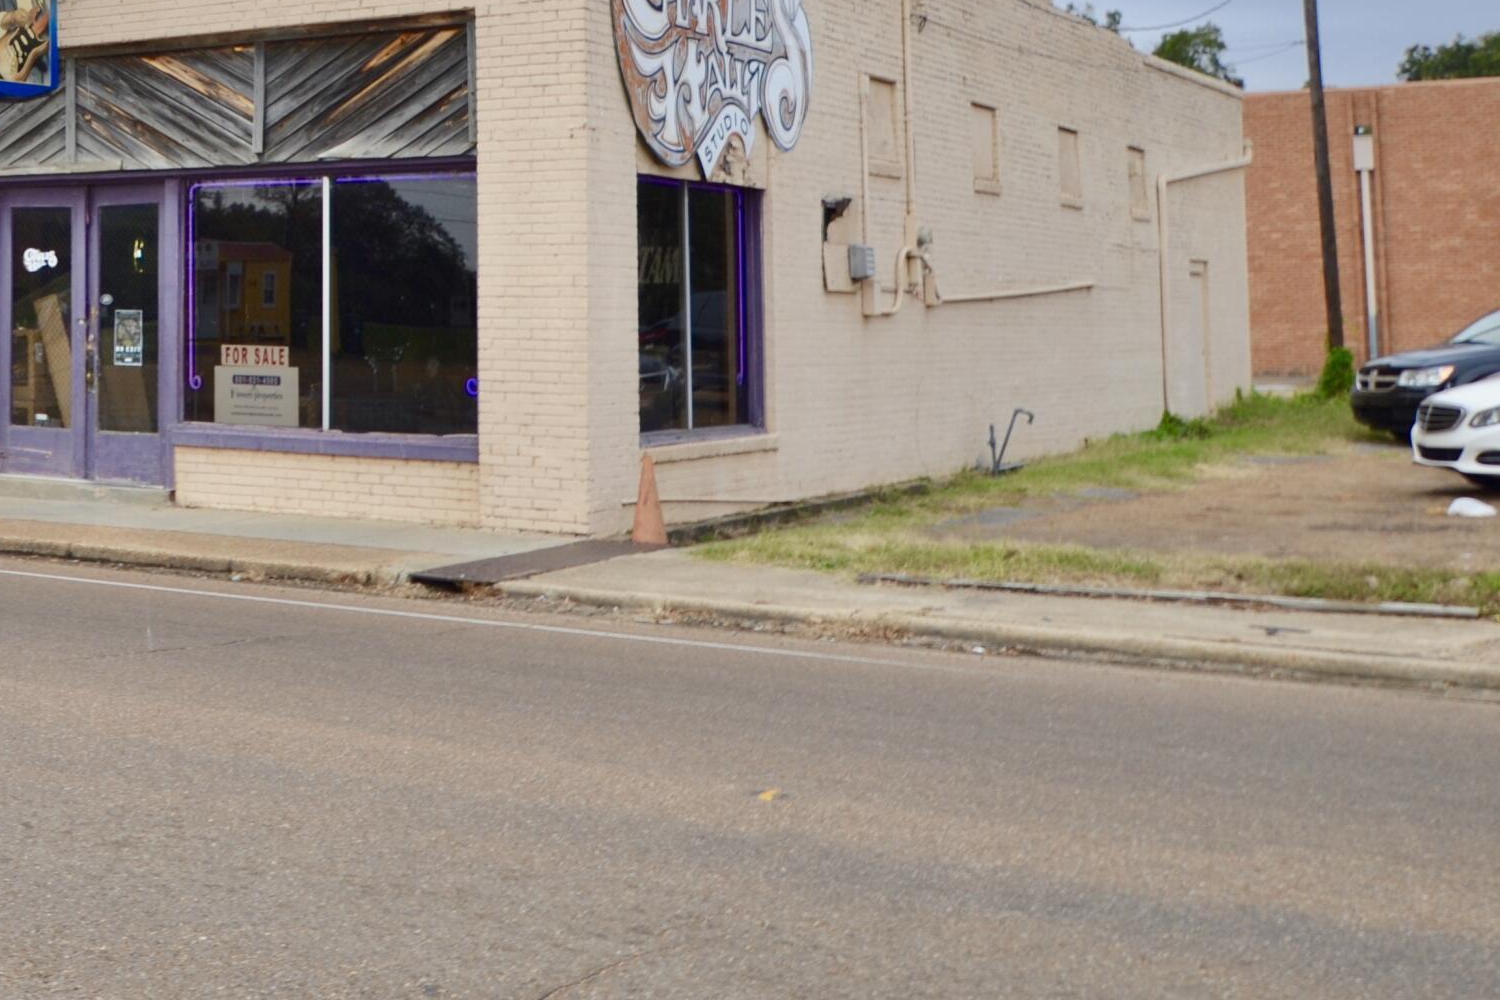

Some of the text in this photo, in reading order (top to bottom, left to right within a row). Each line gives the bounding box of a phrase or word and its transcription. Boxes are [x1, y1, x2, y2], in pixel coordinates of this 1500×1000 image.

[704, 114, 750, 163] STUDIO
[225, 347, 285, 365] FOR SALE
